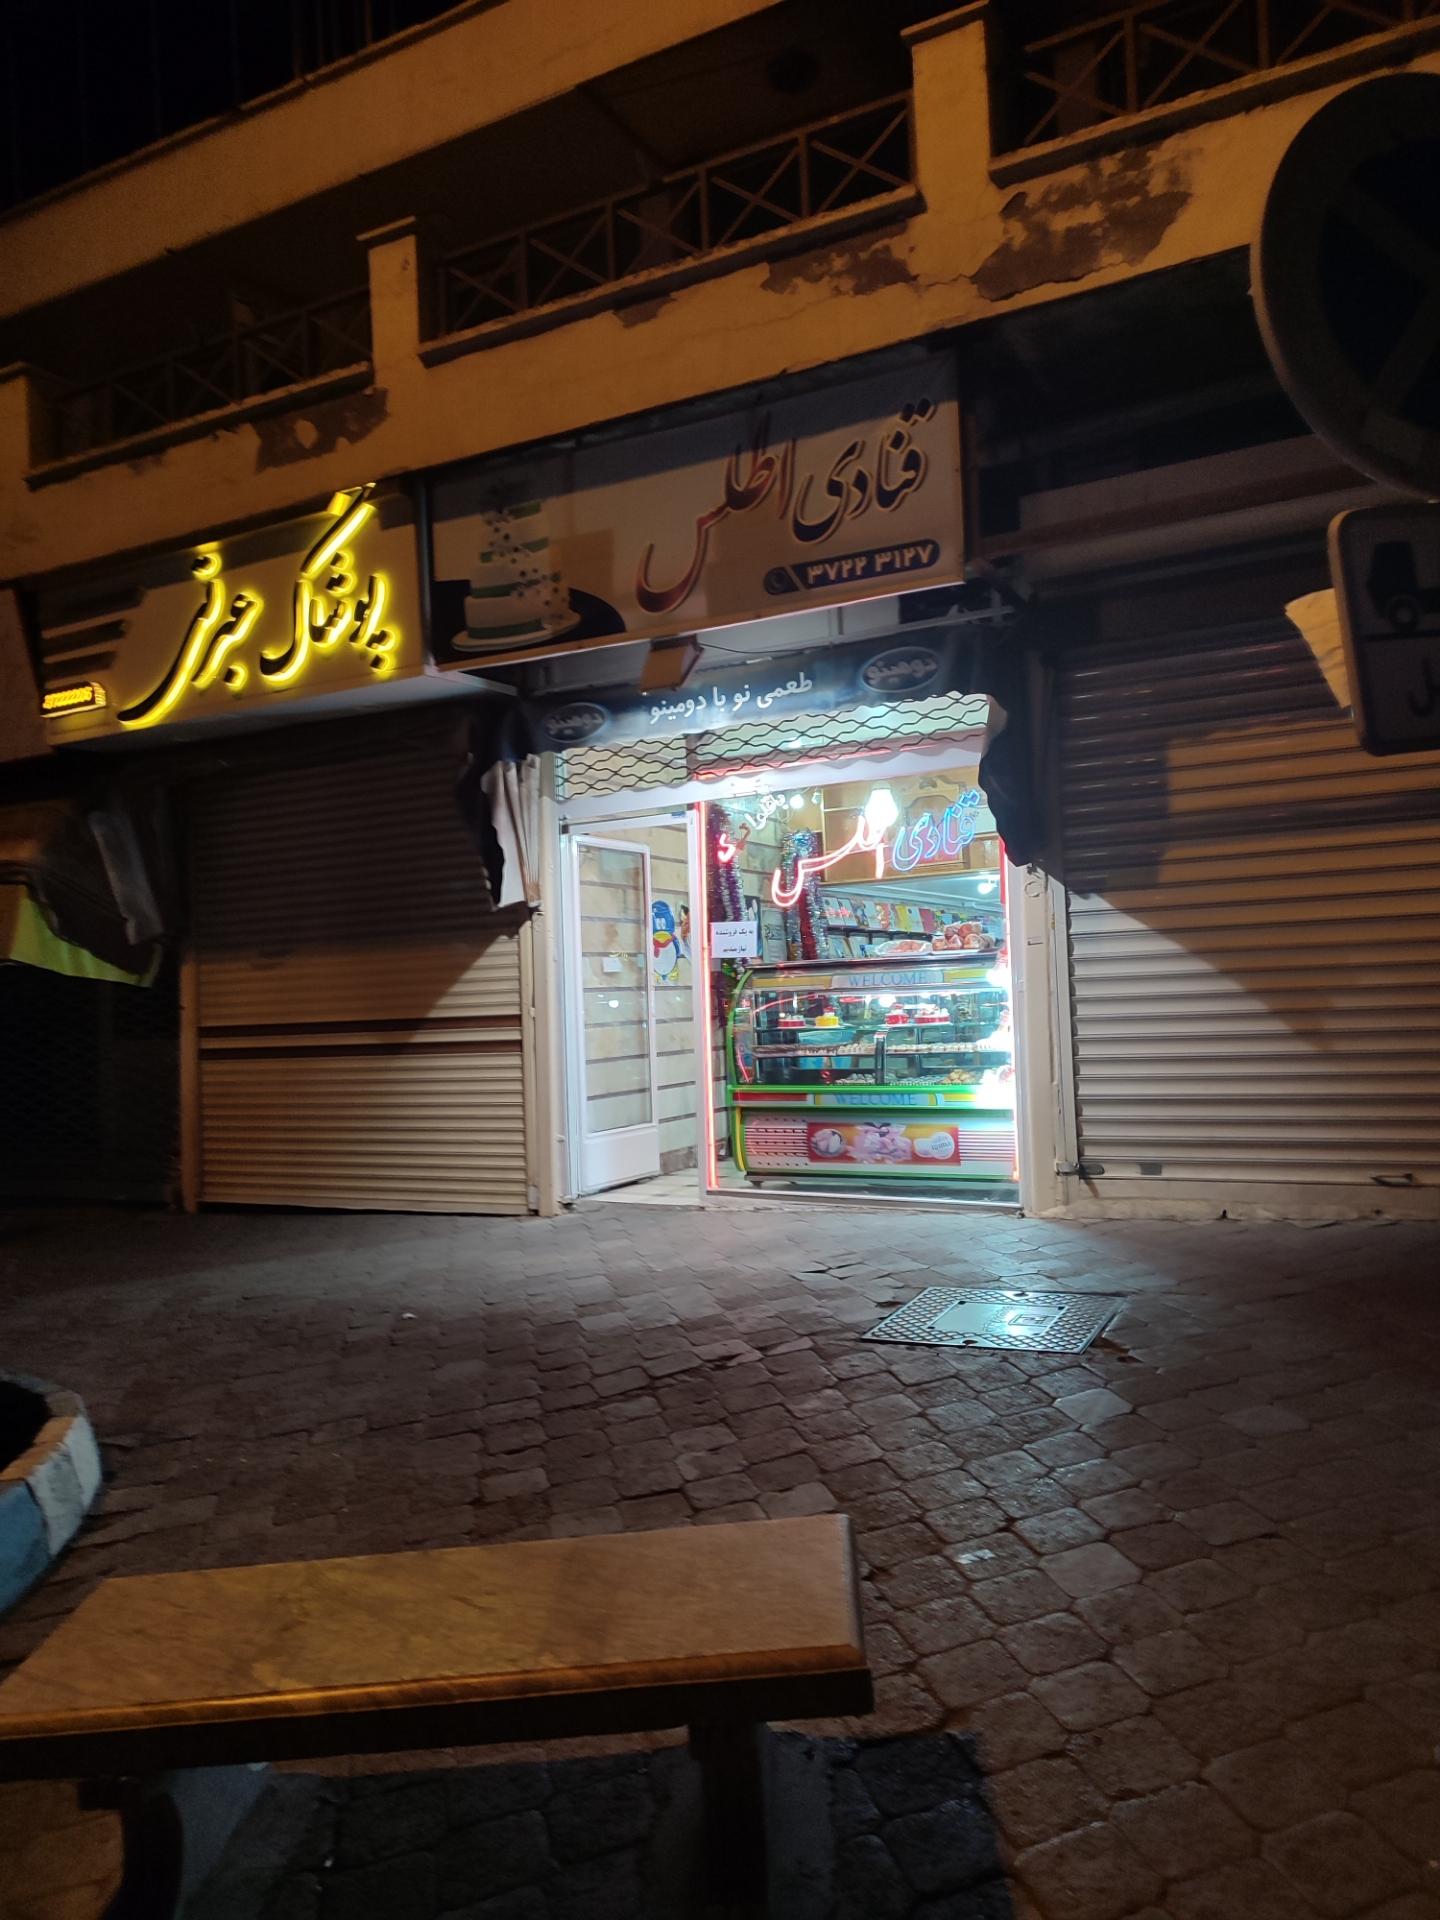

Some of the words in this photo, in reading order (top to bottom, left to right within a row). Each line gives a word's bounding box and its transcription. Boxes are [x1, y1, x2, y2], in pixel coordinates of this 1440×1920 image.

[792, 397, 933, 544] قنادی
[635, 406, 797, 613] اطلس
[806, 556, 867, 584] ۳۷۲۲
[874, 544, 933, 572] ۳۱۲۷
[260, 486, 398, 682] پوشاک
[757, 671, 813, 709] طعمی
[866, 658, 937, 685] دومینو
[650, 696, 706, 724] دومینو
[713, 686, 726, 711] با
[732, 684, 750, 711] نو
[893, 789, 980, 872] قنادی
[848, 972, 927, 986] WELCOME
